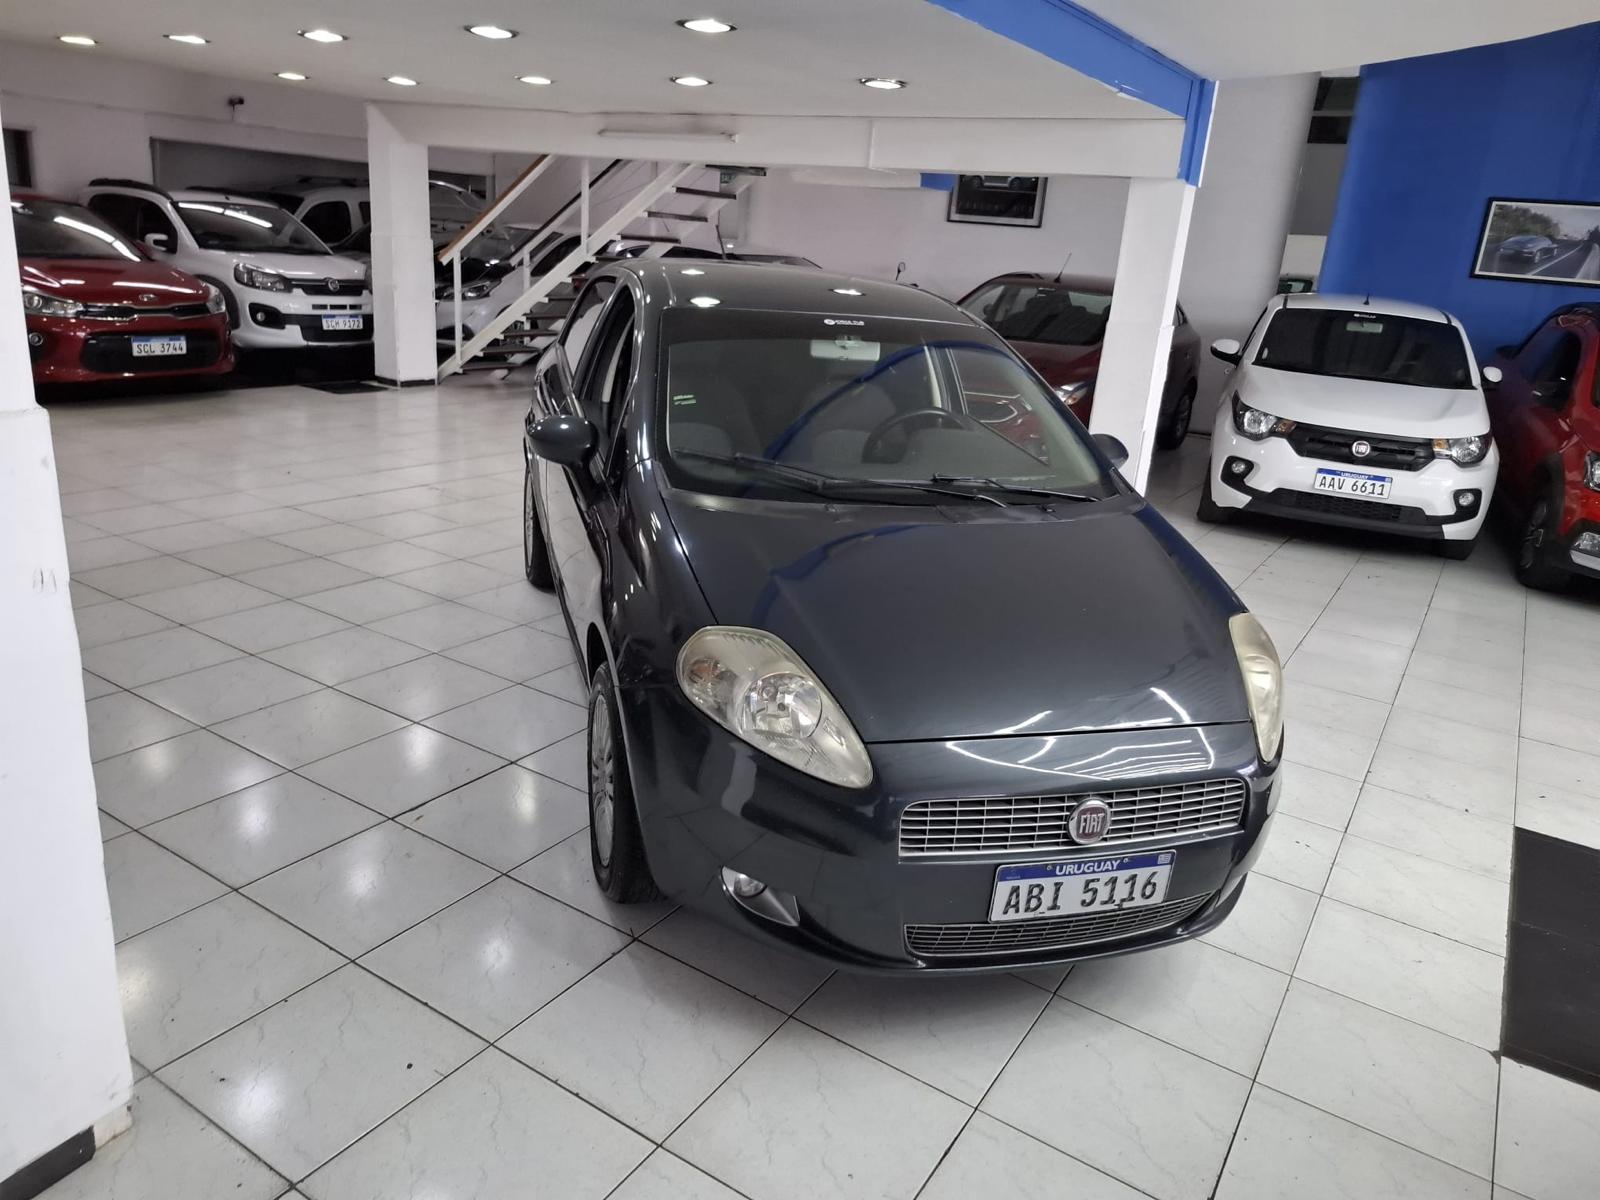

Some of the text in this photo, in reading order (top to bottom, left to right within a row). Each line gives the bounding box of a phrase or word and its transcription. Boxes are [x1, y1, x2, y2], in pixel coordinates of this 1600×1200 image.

[136, 342, 183, 354] SCL 3744
[1319, 475, 1385, 496] AAV 6611
[1079, 812, 1105, 834] FIAT
[1055, 859, 1121, 876] URUGUAY
[1002, 871, 1159, 915] ABI 5116
